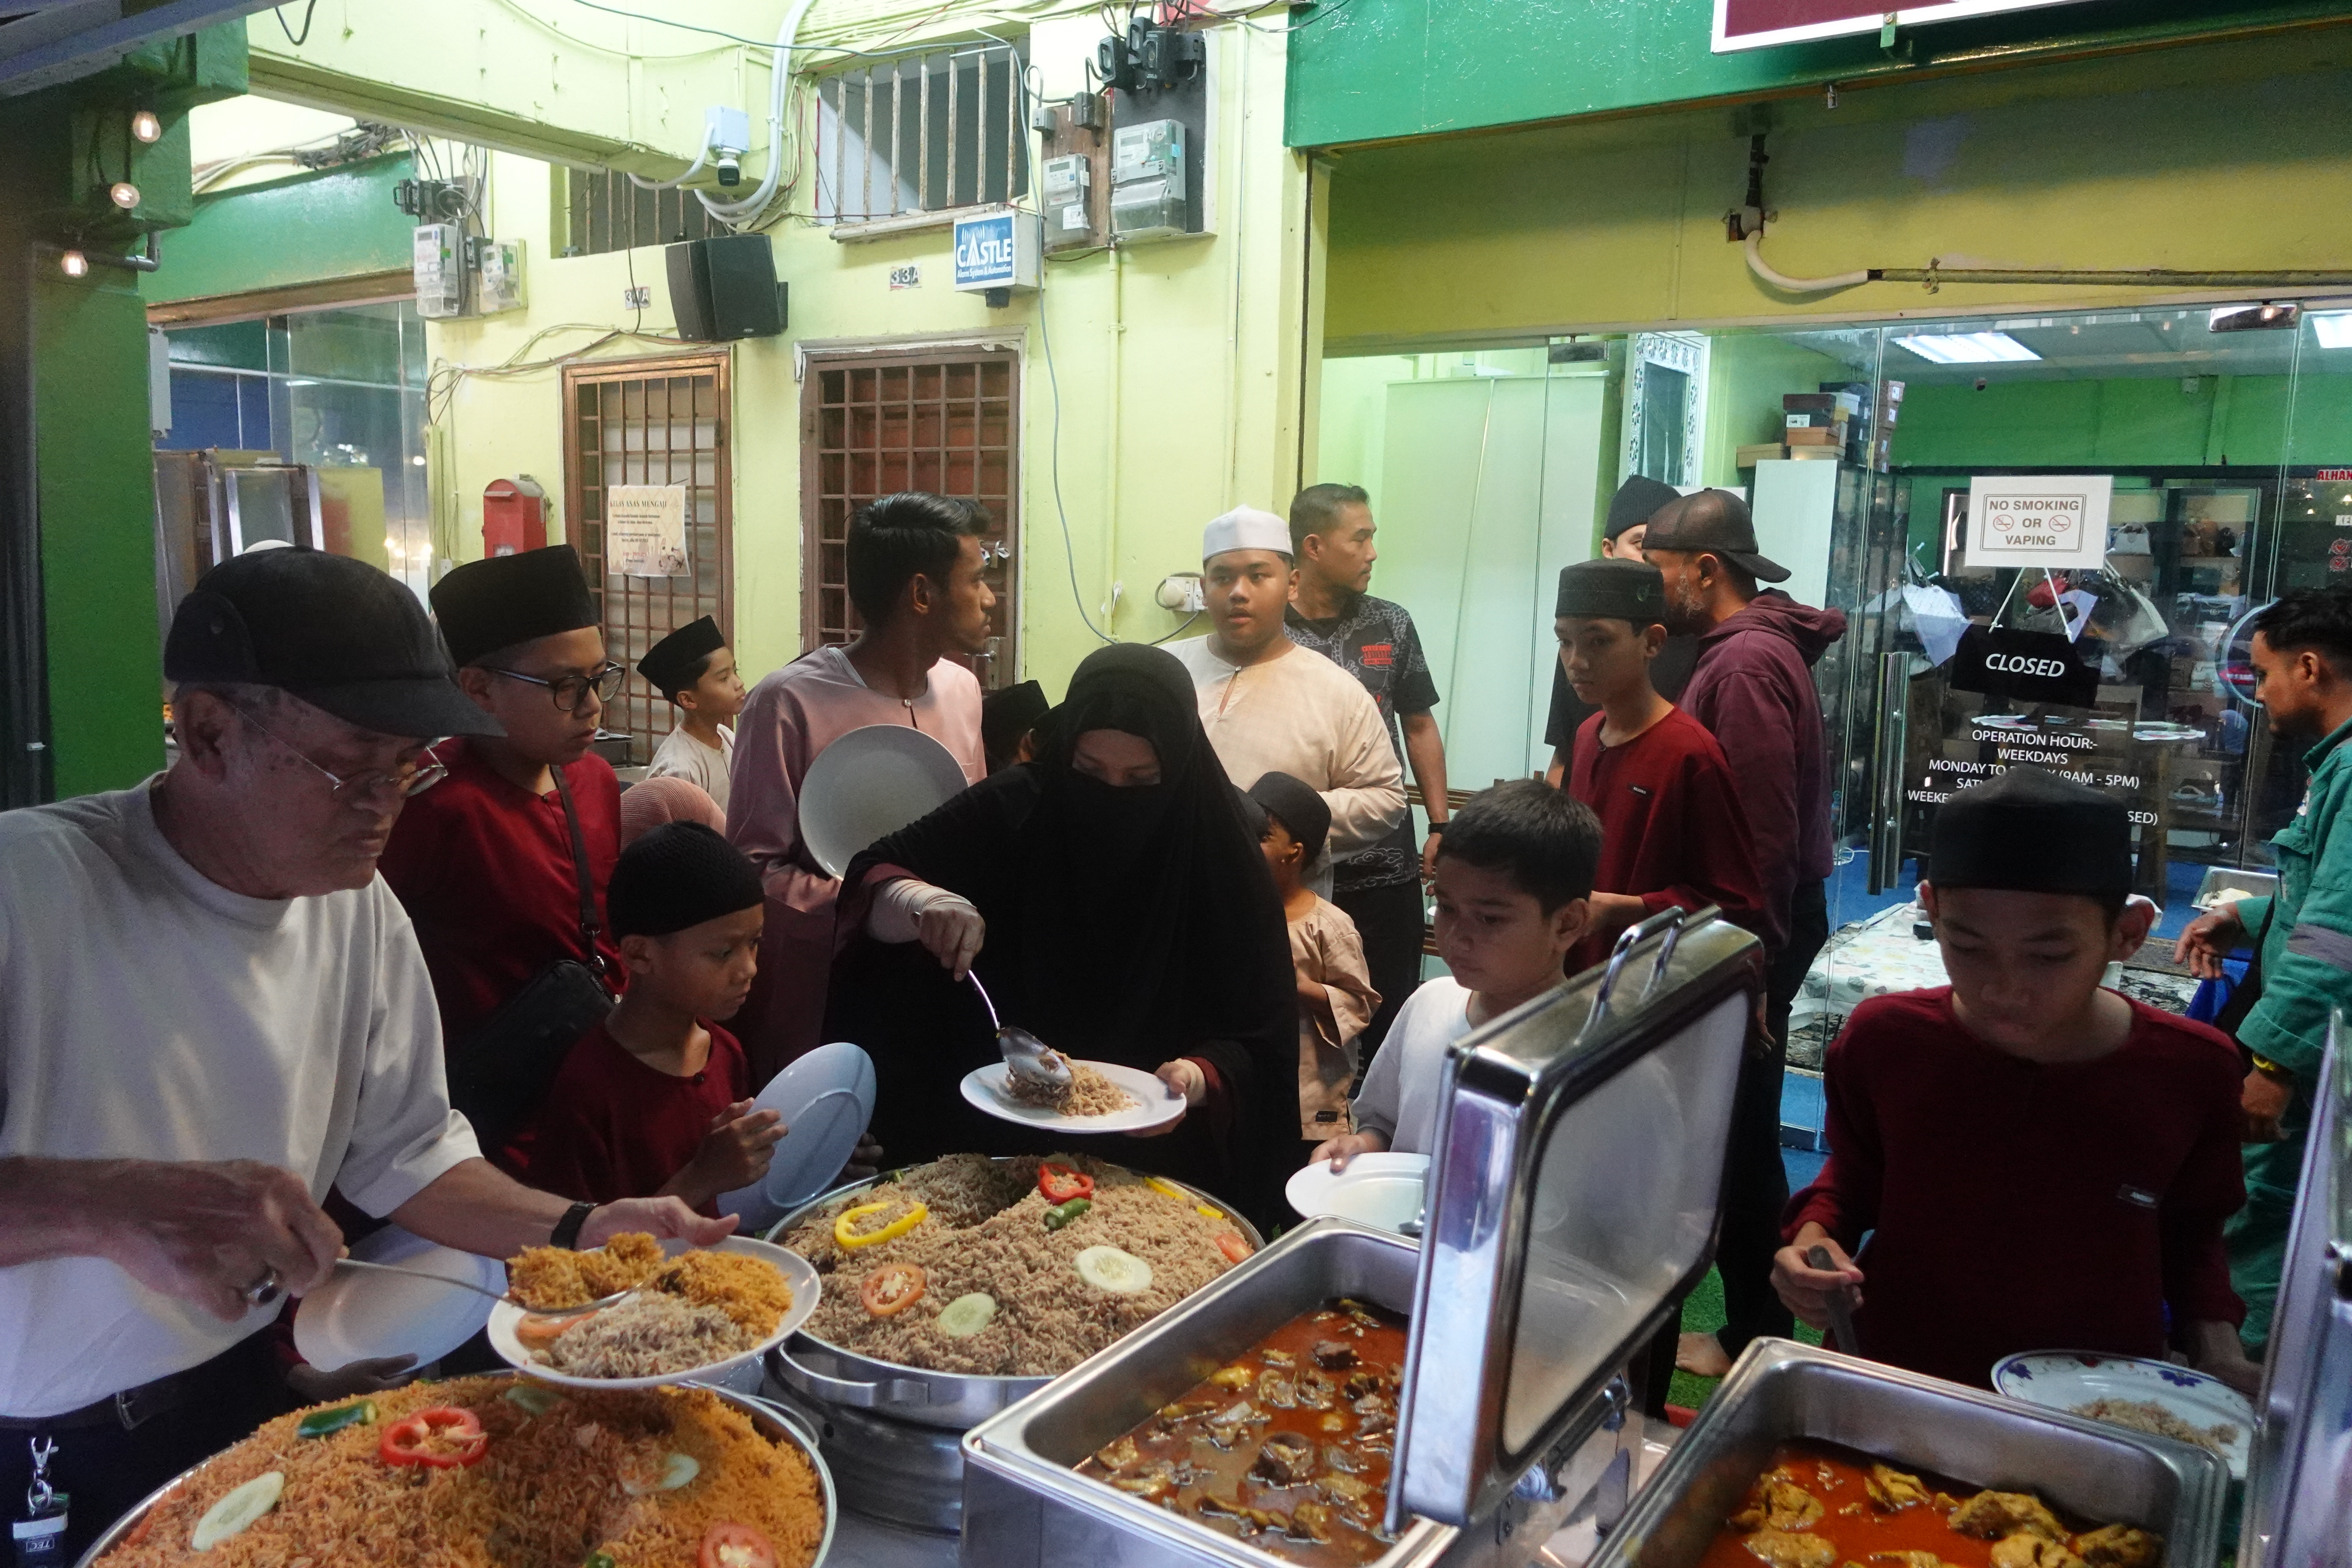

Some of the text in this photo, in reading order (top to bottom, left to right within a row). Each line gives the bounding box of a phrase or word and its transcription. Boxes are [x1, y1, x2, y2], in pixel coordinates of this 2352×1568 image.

[957, 233, 1011, 268] CASTLE
[891, 267, 921, 284] 33A
[957, 264, 1011, 279] Alarm System & Automation
[1989, 500, 2079, 510] NO SMOKING
[2022, 518, 2042, 528] OR
[2005, 535, 2056, 545] VAPING
[1985, 653, 2065, 677] CLOSED
[1972, 729, 2098, 749] OPERATION HOUR:-
[1997, 748, 2068, 764] WEEKDAYS
[1928, 759, 1987, 774] MONDAY
[1988, 764, 2006, 775] TO
[2104, 774, 2140, 789] 5PM)
